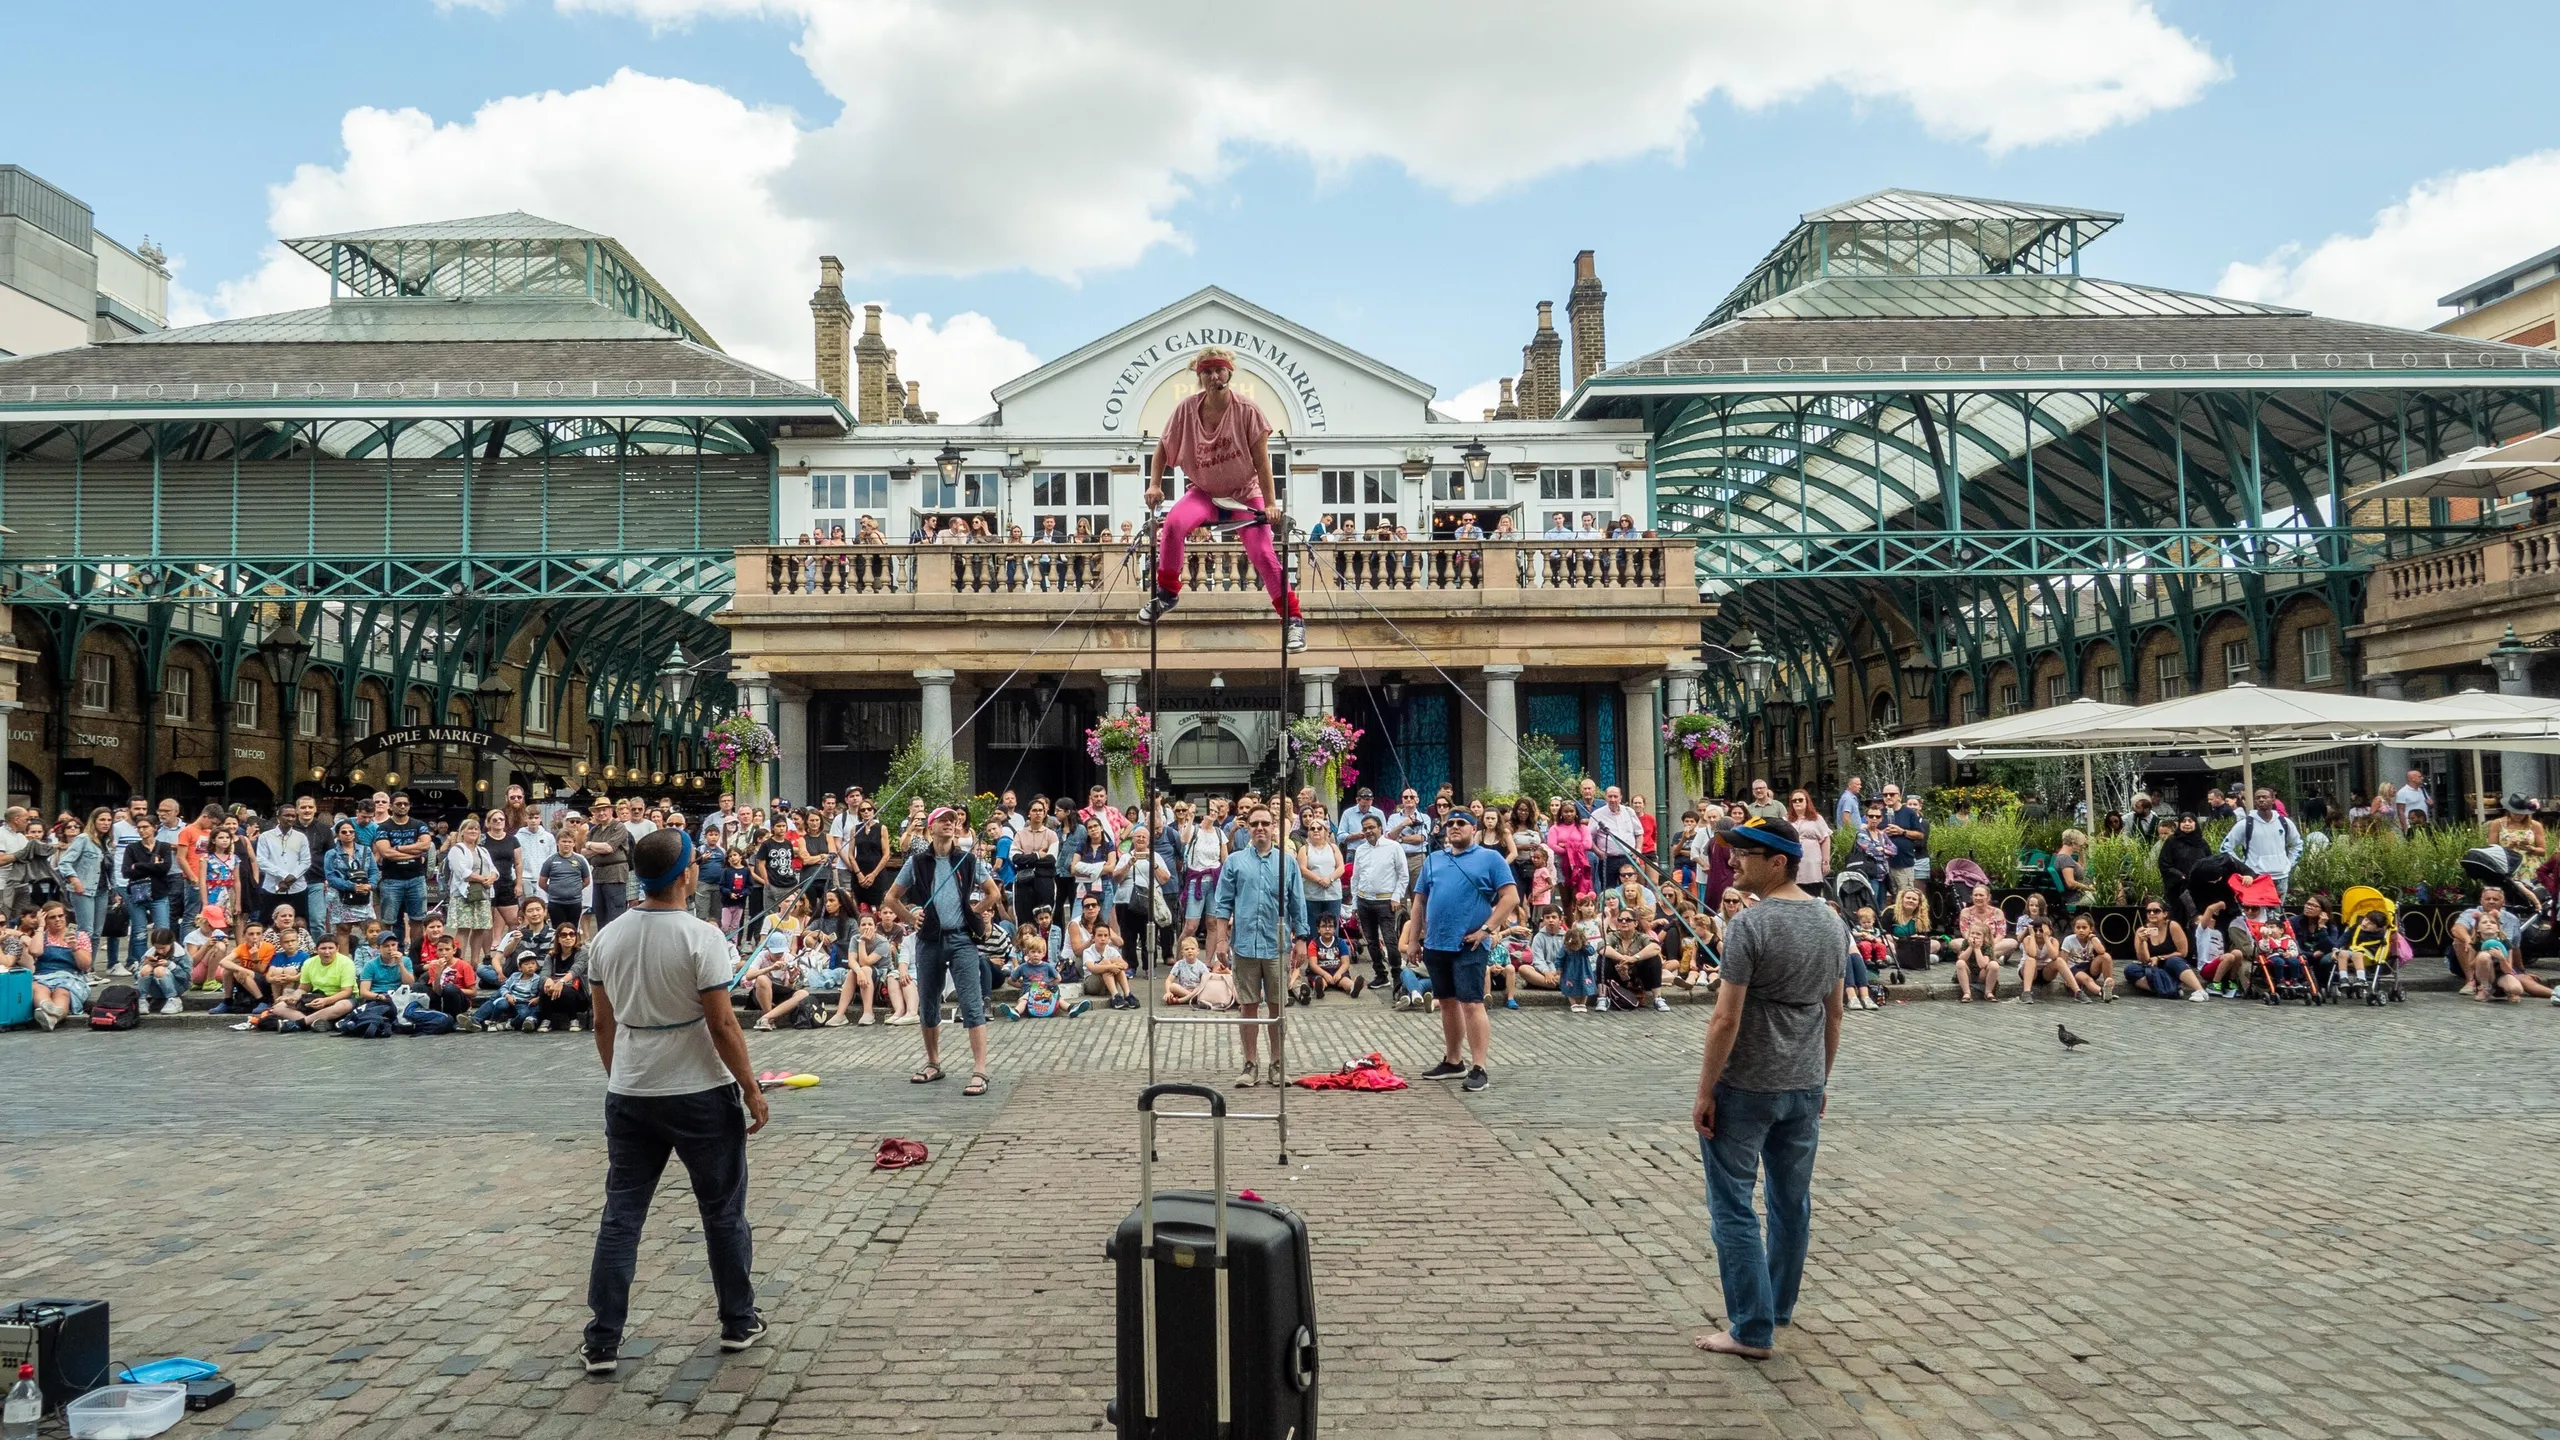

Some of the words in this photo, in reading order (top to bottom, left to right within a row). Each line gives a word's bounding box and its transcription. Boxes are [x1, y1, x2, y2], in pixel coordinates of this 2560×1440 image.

[1102, 344, 1159, 432] COVENT
[1165, 328, 1267, 353] GARDEN
[1264, 343, 1327, 432] MARKET
[1147, 697, 1221, 709] ENTRAL
[1178, 712, 1200, 726] CENTR
[77, 733, 96, 745] TOM
[96, 735, 119, 748] FORD
[378, 729, 421, 748] APPLE
[428, 728, 492, 745] MARKET
[234, 748, 248, 759] TOM
[248, 749, 266, 760] FORD
